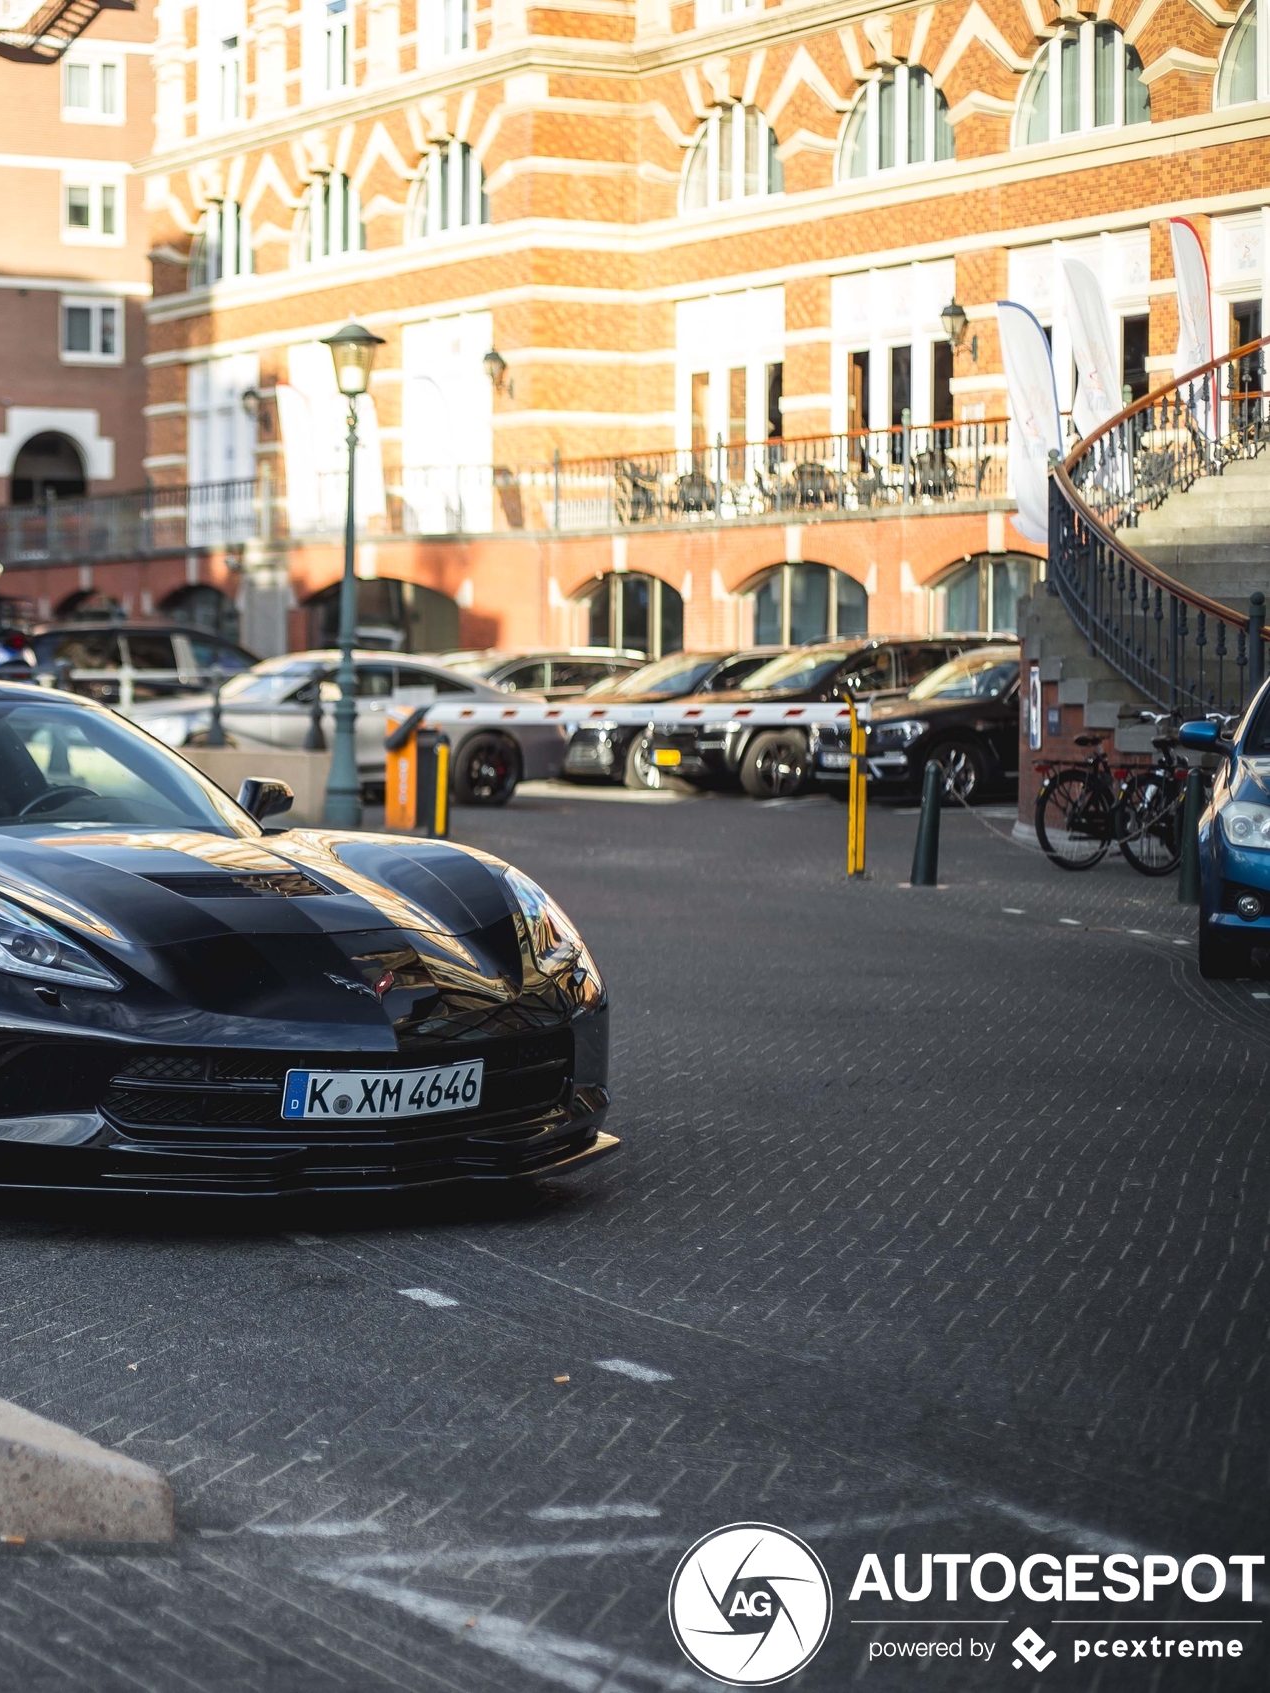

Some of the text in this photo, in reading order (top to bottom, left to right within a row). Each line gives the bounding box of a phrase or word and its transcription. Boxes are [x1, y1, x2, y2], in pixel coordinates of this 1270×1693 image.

[290, 1099, 299, 1110] D
[307, 1067, 478, 1114] K XM 4646
